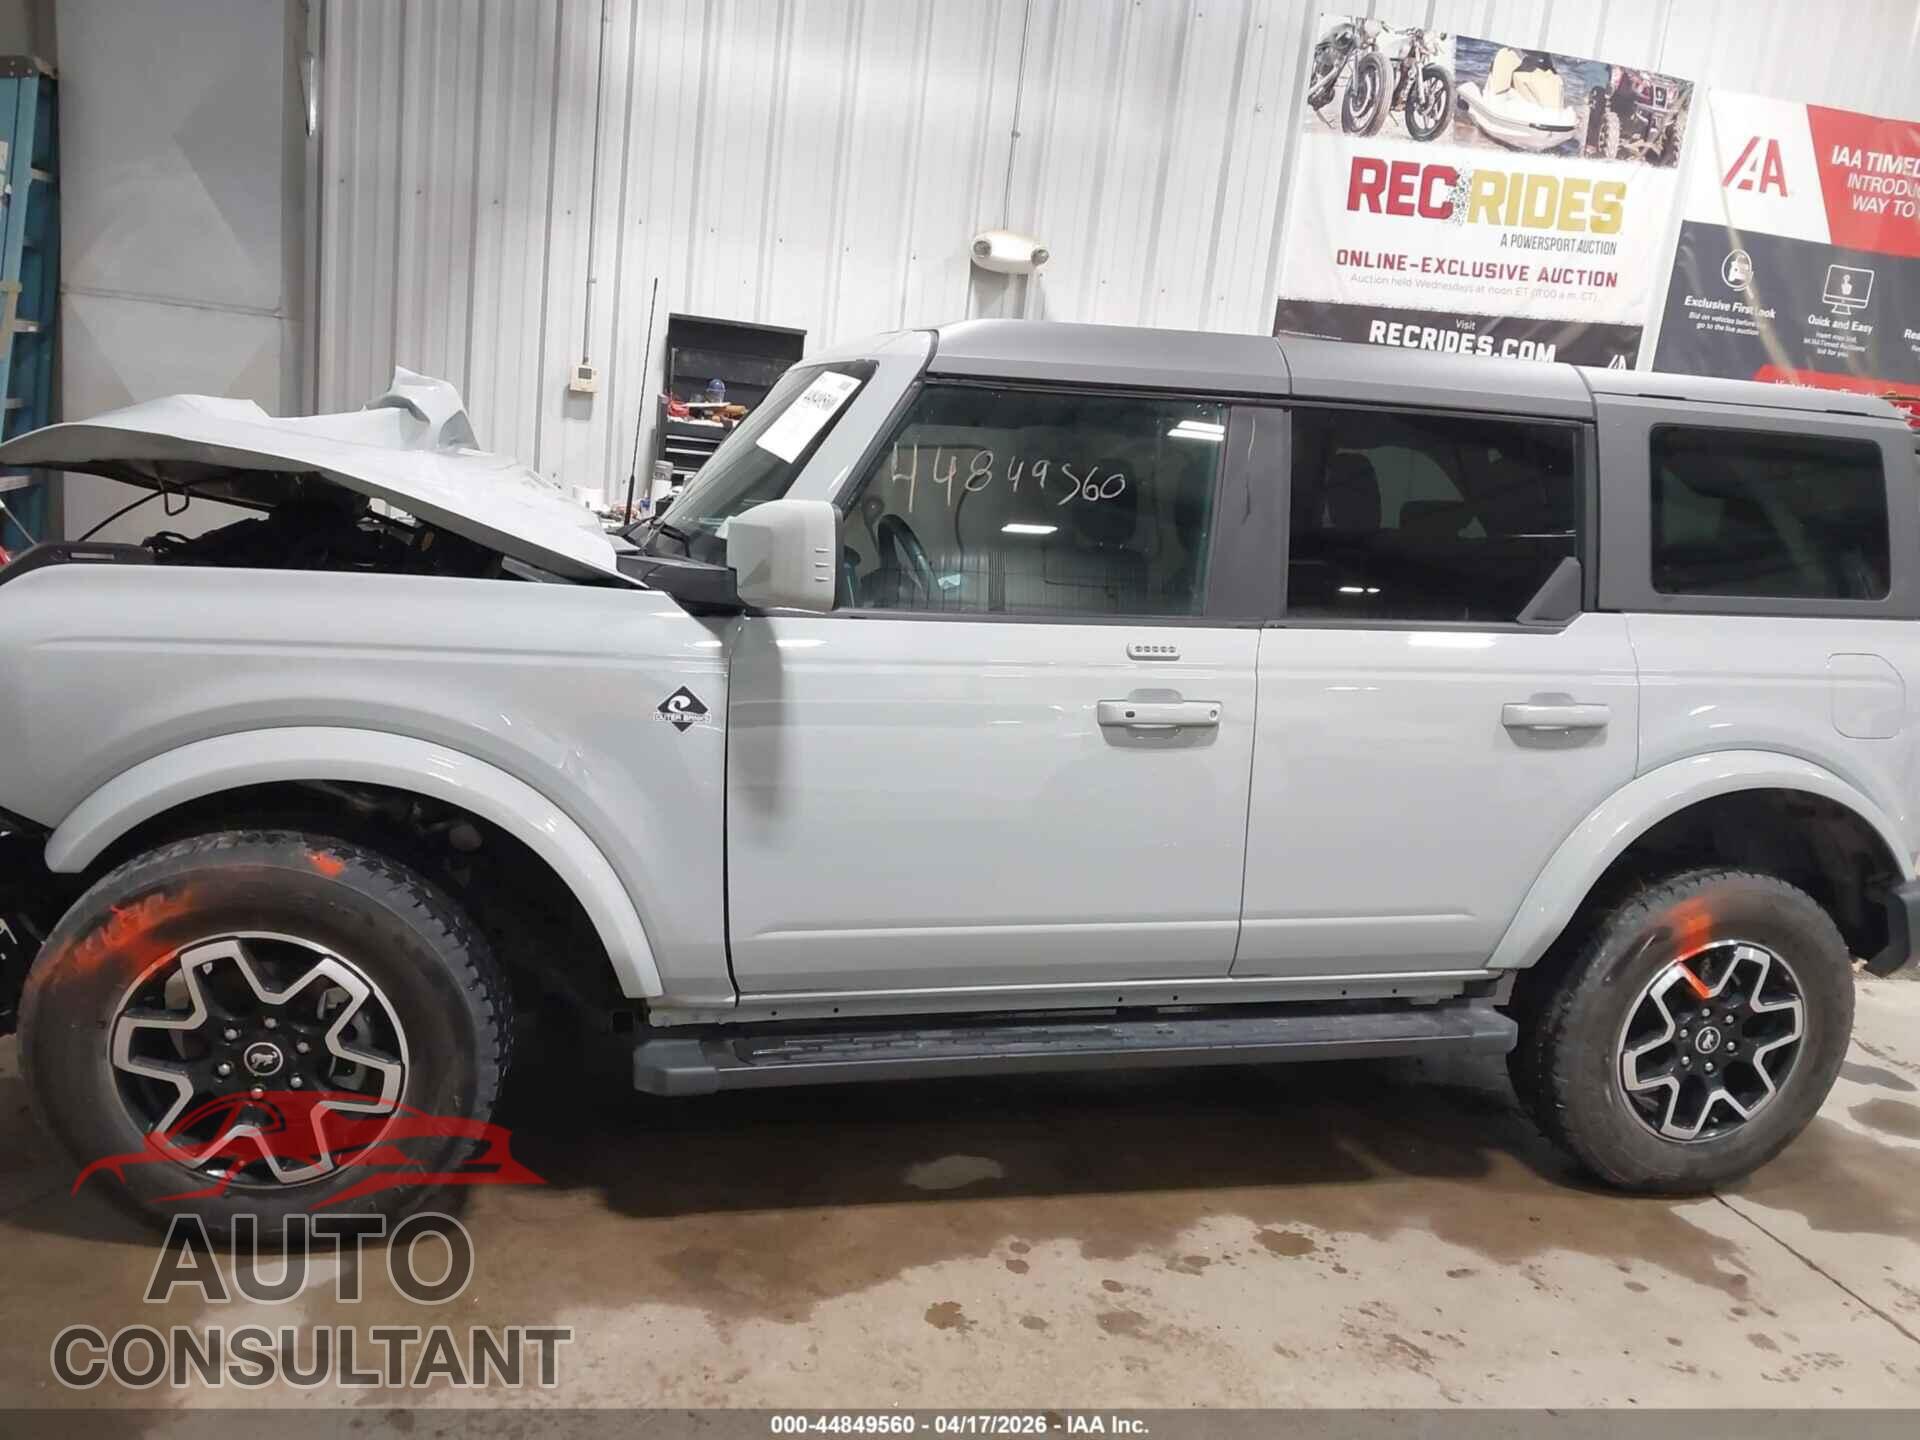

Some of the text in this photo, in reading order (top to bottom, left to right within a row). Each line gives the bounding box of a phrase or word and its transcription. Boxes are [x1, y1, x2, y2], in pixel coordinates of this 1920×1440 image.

[1831, 144, 1862, 169] IAA
[1347, 156, 1627, 235] REC RIDES
[1853, 193, 1915, 218] WAY TO
[1500, 233, 1617, 255] A POWERSPORT AUCTION
[1336, 249, 1618, 288] ONLINE-EXCLUSIVE AUCTION
[1684, 295, 1730, 311] Exclusive
[1456, 319, 1475, 331] Visit
[1808, 314, 1873, 335] Quick and Easy
[1369, 319, 1556, 363] RECRIDES.COM
